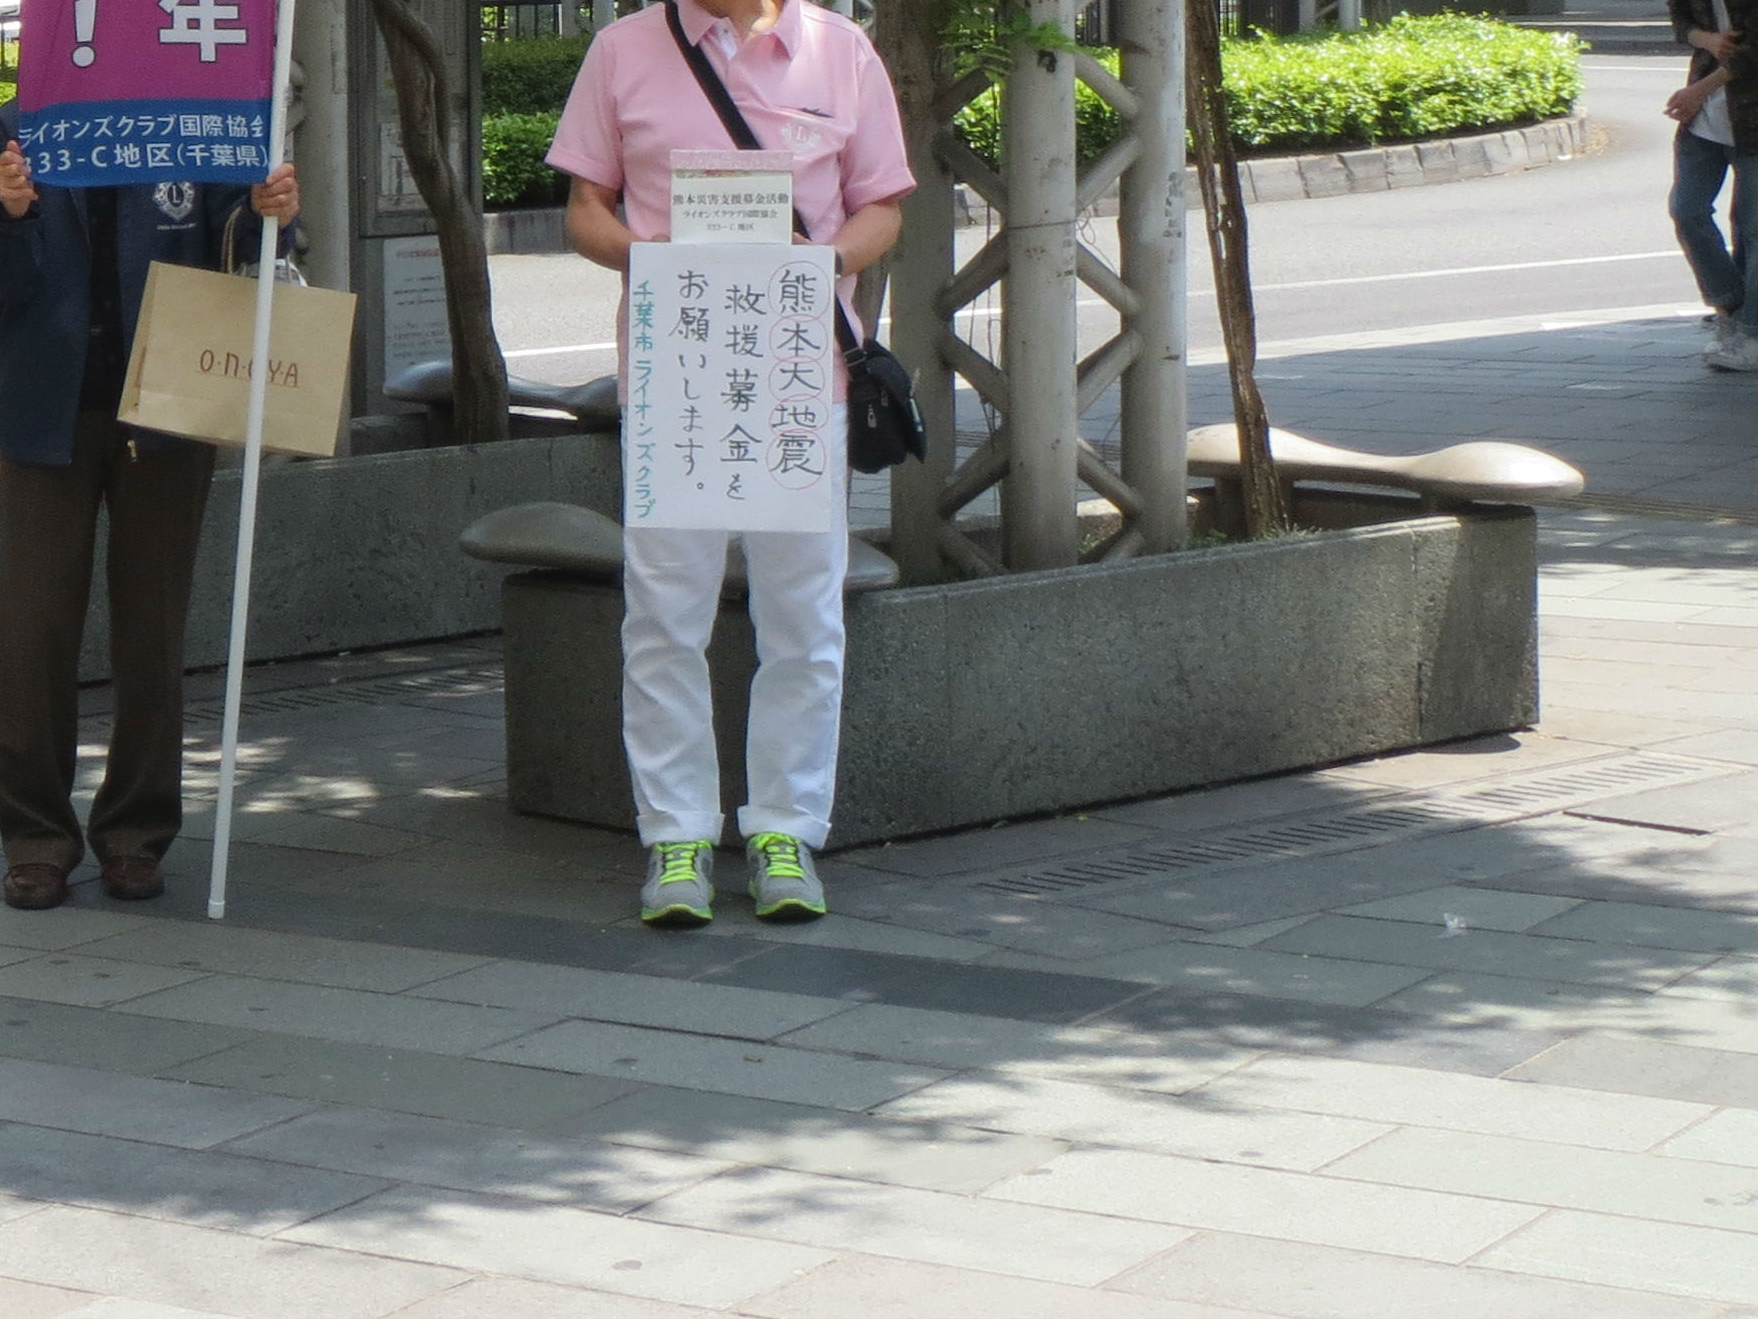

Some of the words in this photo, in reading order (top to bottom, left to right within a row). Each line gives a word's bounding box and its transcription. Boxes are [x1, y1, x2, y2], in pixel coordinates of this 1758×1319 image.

[18, 114, 264, 149] ライオンズクラブ国際協会
[667, 269, 710, 491] お願いします。
[719, 284, 768, 500] 救援募金を
[768, 269, 824, 476] 熊本大地震
